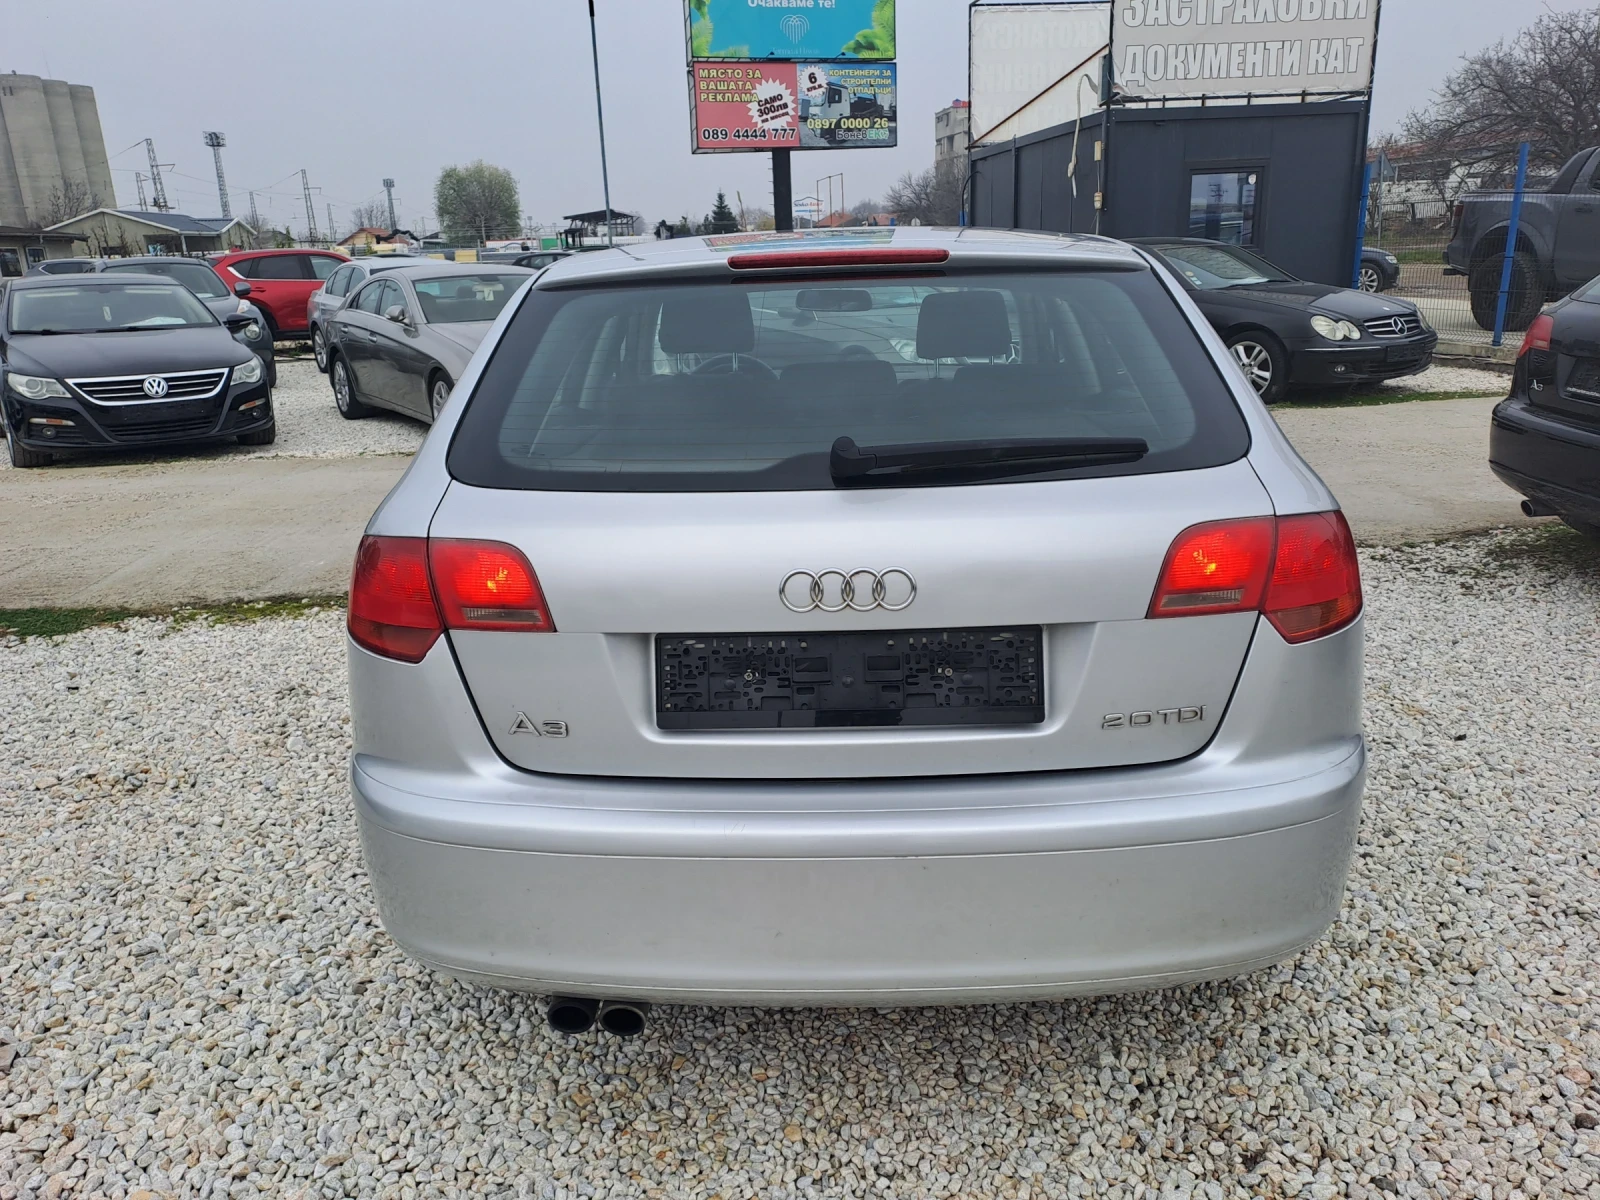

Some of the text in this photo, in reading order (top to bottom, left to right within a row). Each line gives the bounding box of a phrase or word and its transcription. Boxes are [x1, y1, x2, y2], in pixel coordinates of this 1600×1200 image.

[748, 0, 836, 8] Очакваме те!
[1122, 0, 1368, 27] ЗАСТРАХОВКИ
[1122, 39, 1302, 87] ДОКУМЕНТИ
[1307, 37, 1365, 75] КАТ
[699, 69, 763, 79] МЯСТО ЗА
[808, 72, 818, 84] 6
[829, 69, 880, 77] КОНТЕЙНЕРИ
[699, 80, 753, 90] ВАШАТА
[700, 92, 760, 102] РЕКЛАМА
[757, 93, 784, 108] САМО
[756, 102, 789, 118] 300лв
[807, 117, 889, 129] 0897 0000 26
[702, 128, 797, 141] 089 4444 777
[508, 710, 568, 738] A3
